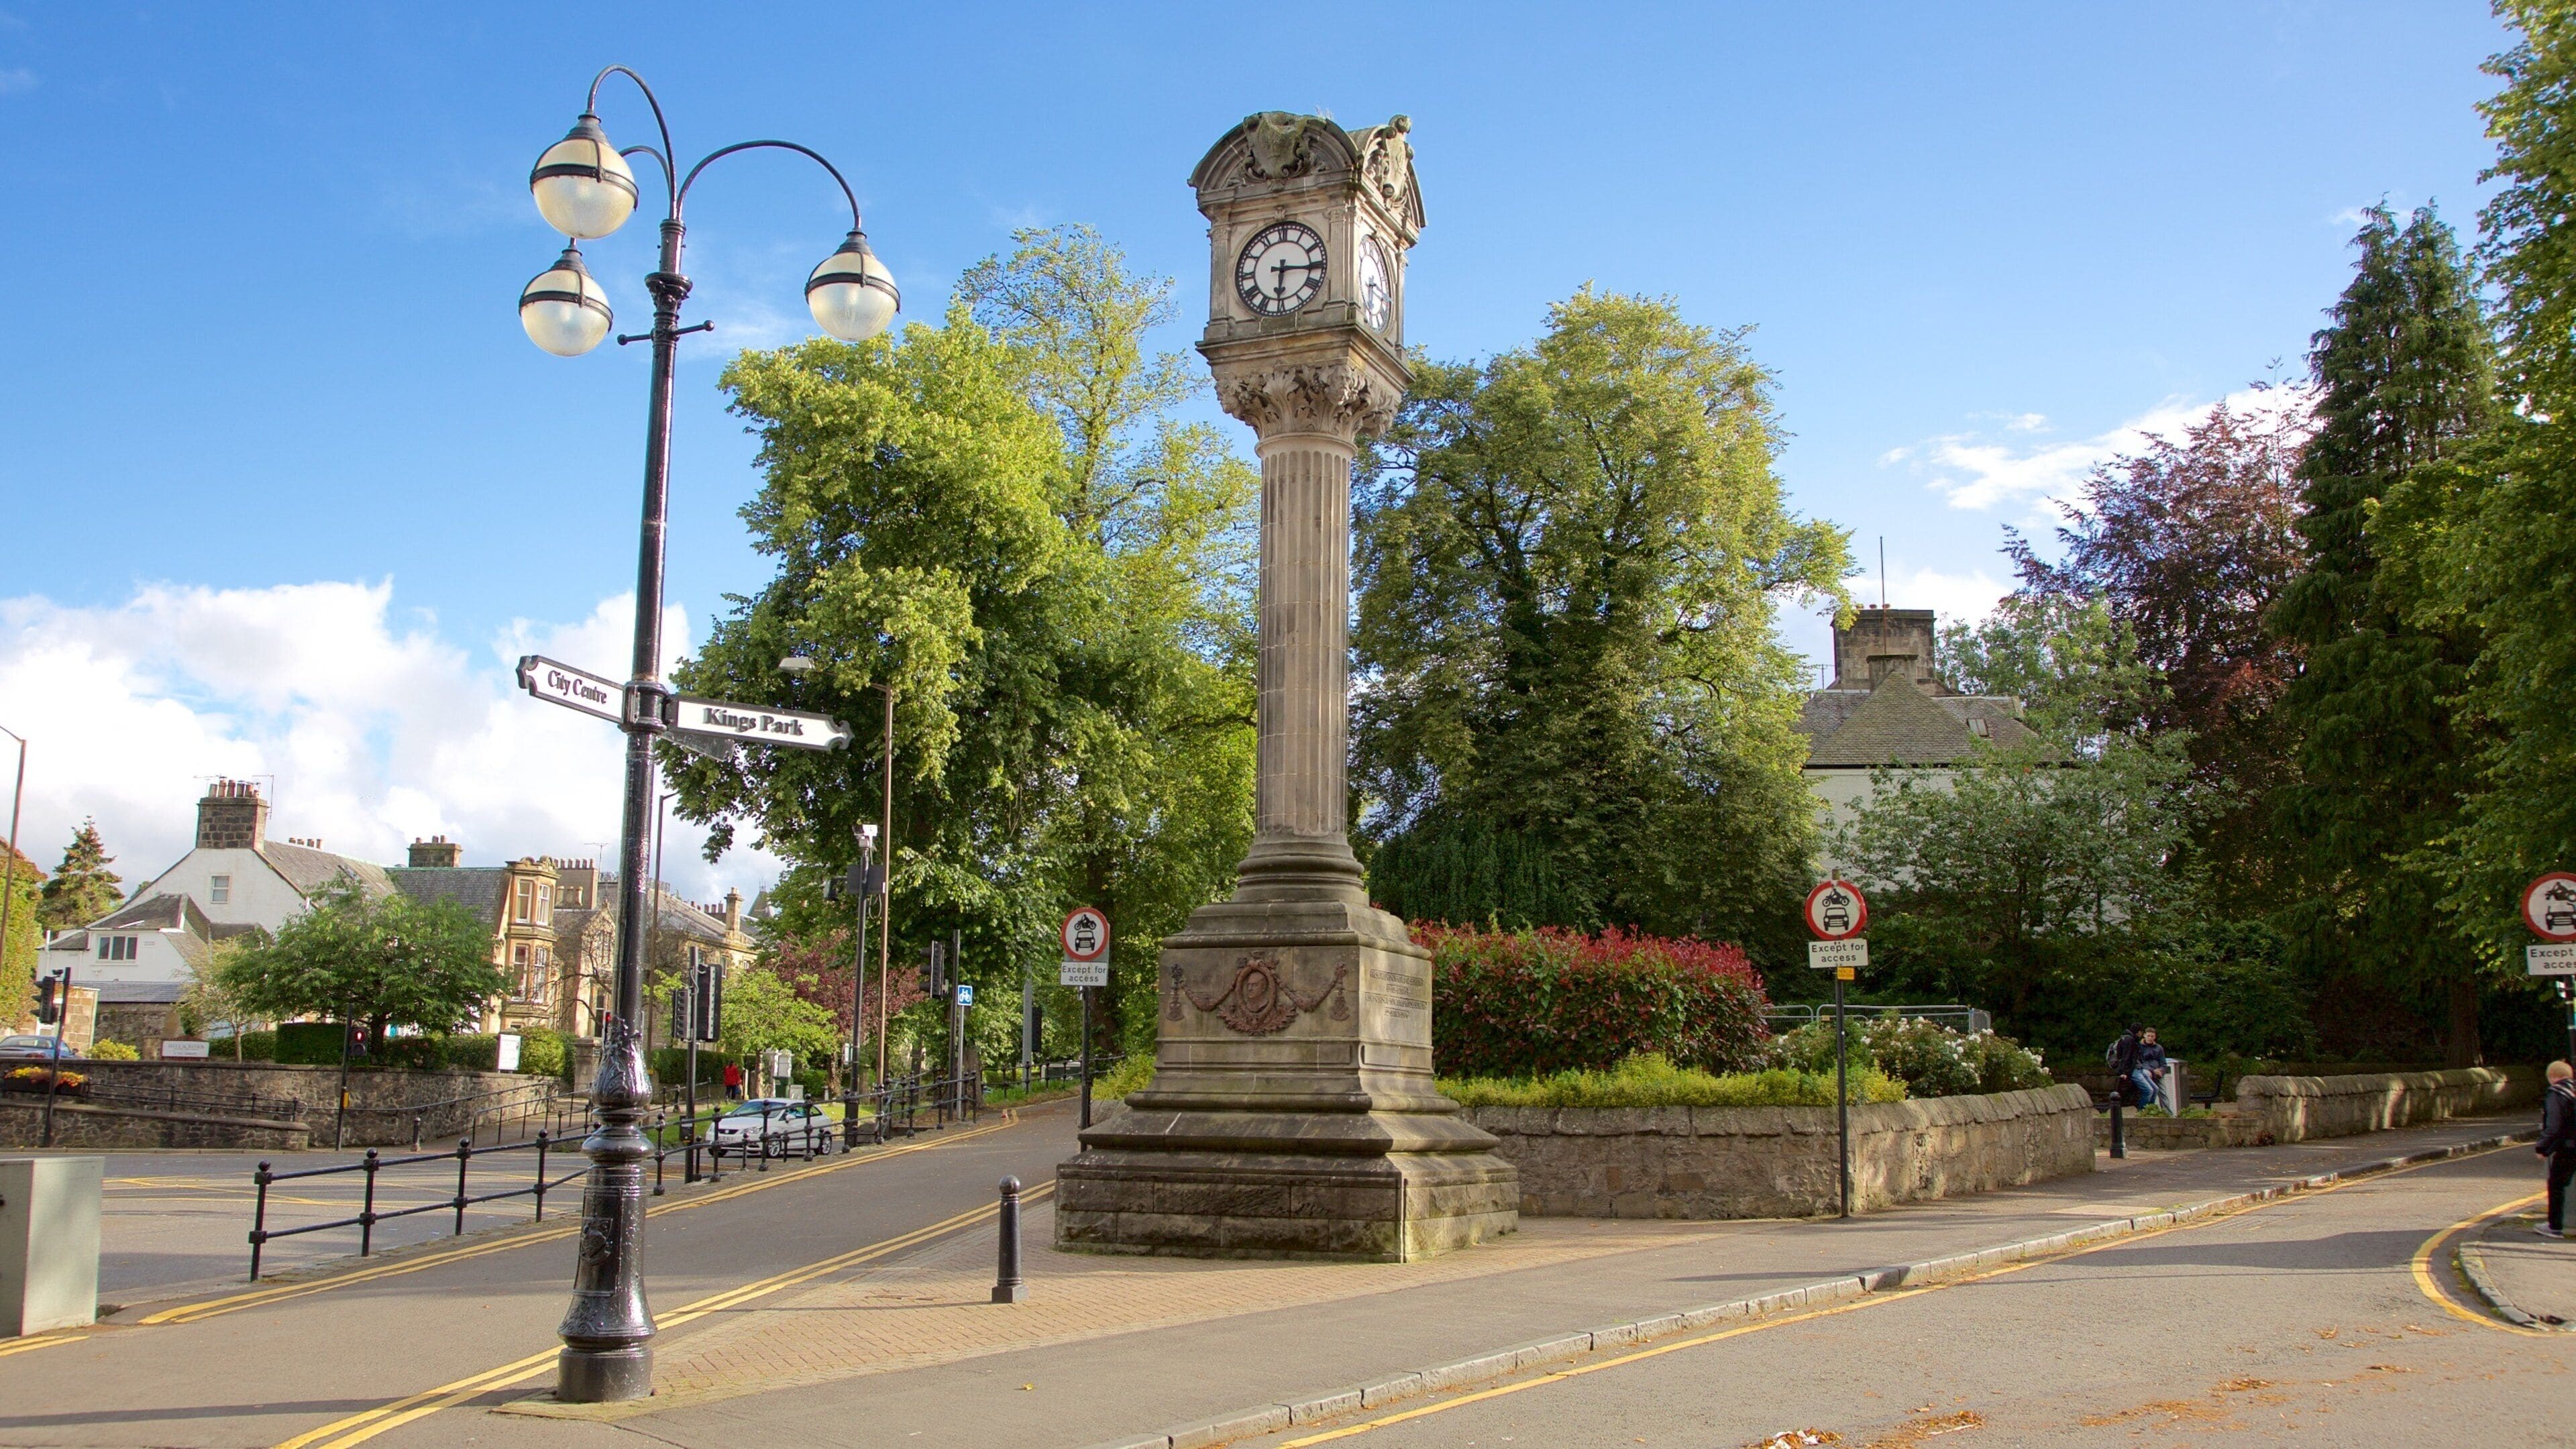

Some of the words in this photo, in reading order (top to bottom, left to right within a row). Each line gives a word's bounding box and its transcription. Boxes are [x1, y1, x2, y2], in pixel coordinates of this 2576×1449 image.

[548, 670, 570, 696] City
[573, 679, 606, 704] Centre
[702, 708, 756, 733] Kings
[759, 715, 804, 736] Park
[1812, 943, 1846, 953] Except
[1851, 943, 1865, 951] for
[2530, 948, 2574, 958] Except
[1821, 954, 1856, 962] access
[1062, 965, 1091, 974] Except
